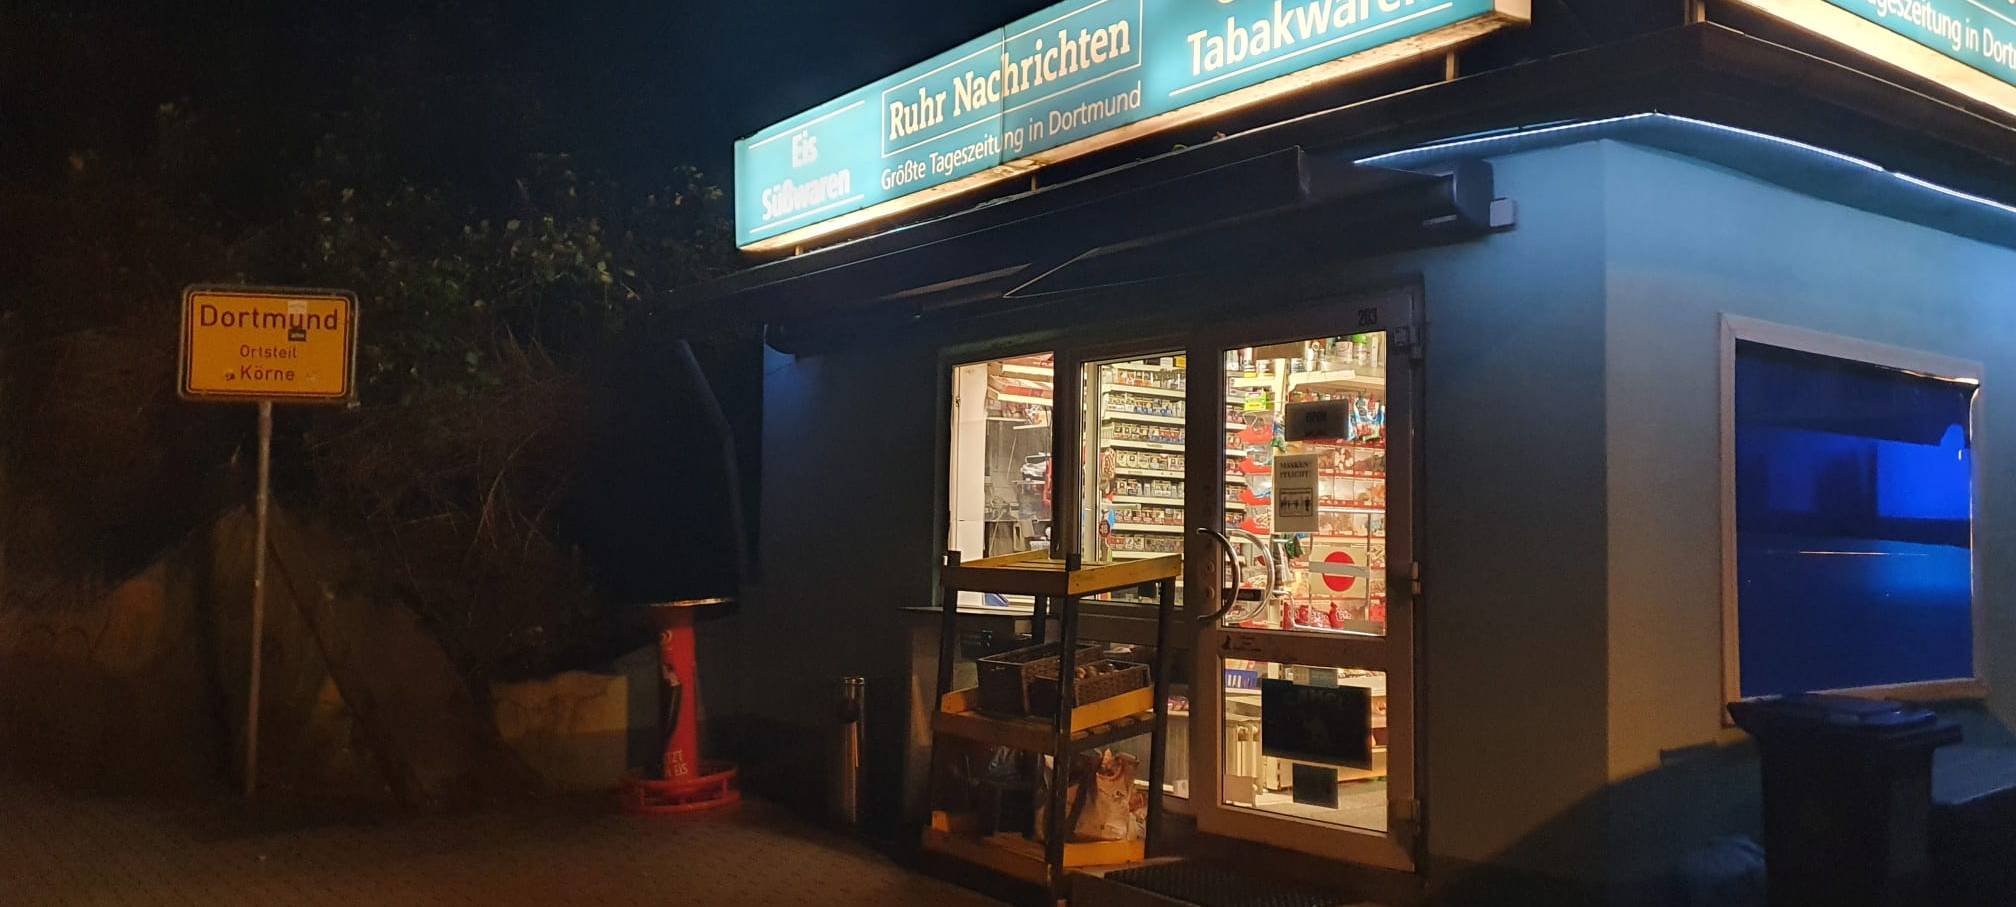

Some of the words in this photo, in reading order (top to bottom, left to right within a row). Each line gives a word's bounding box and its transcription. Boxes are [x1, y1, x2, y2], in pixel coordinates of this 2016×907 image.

[1187, 0, 1414, 76] Tabakwar
[1965, 18, 1979, 51] in
[1983, 28, 2016, 69] Dort
[889, 87, 946, 141] Ruhr
[953, 18, 1130, 117] Nachrichten
[792, 130, 818, 168] Eis
[881, 160, 926, 192] Größte
[929, 126, 1024, 175] Tageszeitung
[1029, 119, 1044, 141] in
[1048, 80, 1142, 133] Dortmund
[762, 169, 850, 220] Süßwaren
[200, 304, 338, 331] Dortmund
[240, 344, 297, 359] Ortsteil
[240, 365, 295, 381] Körne
